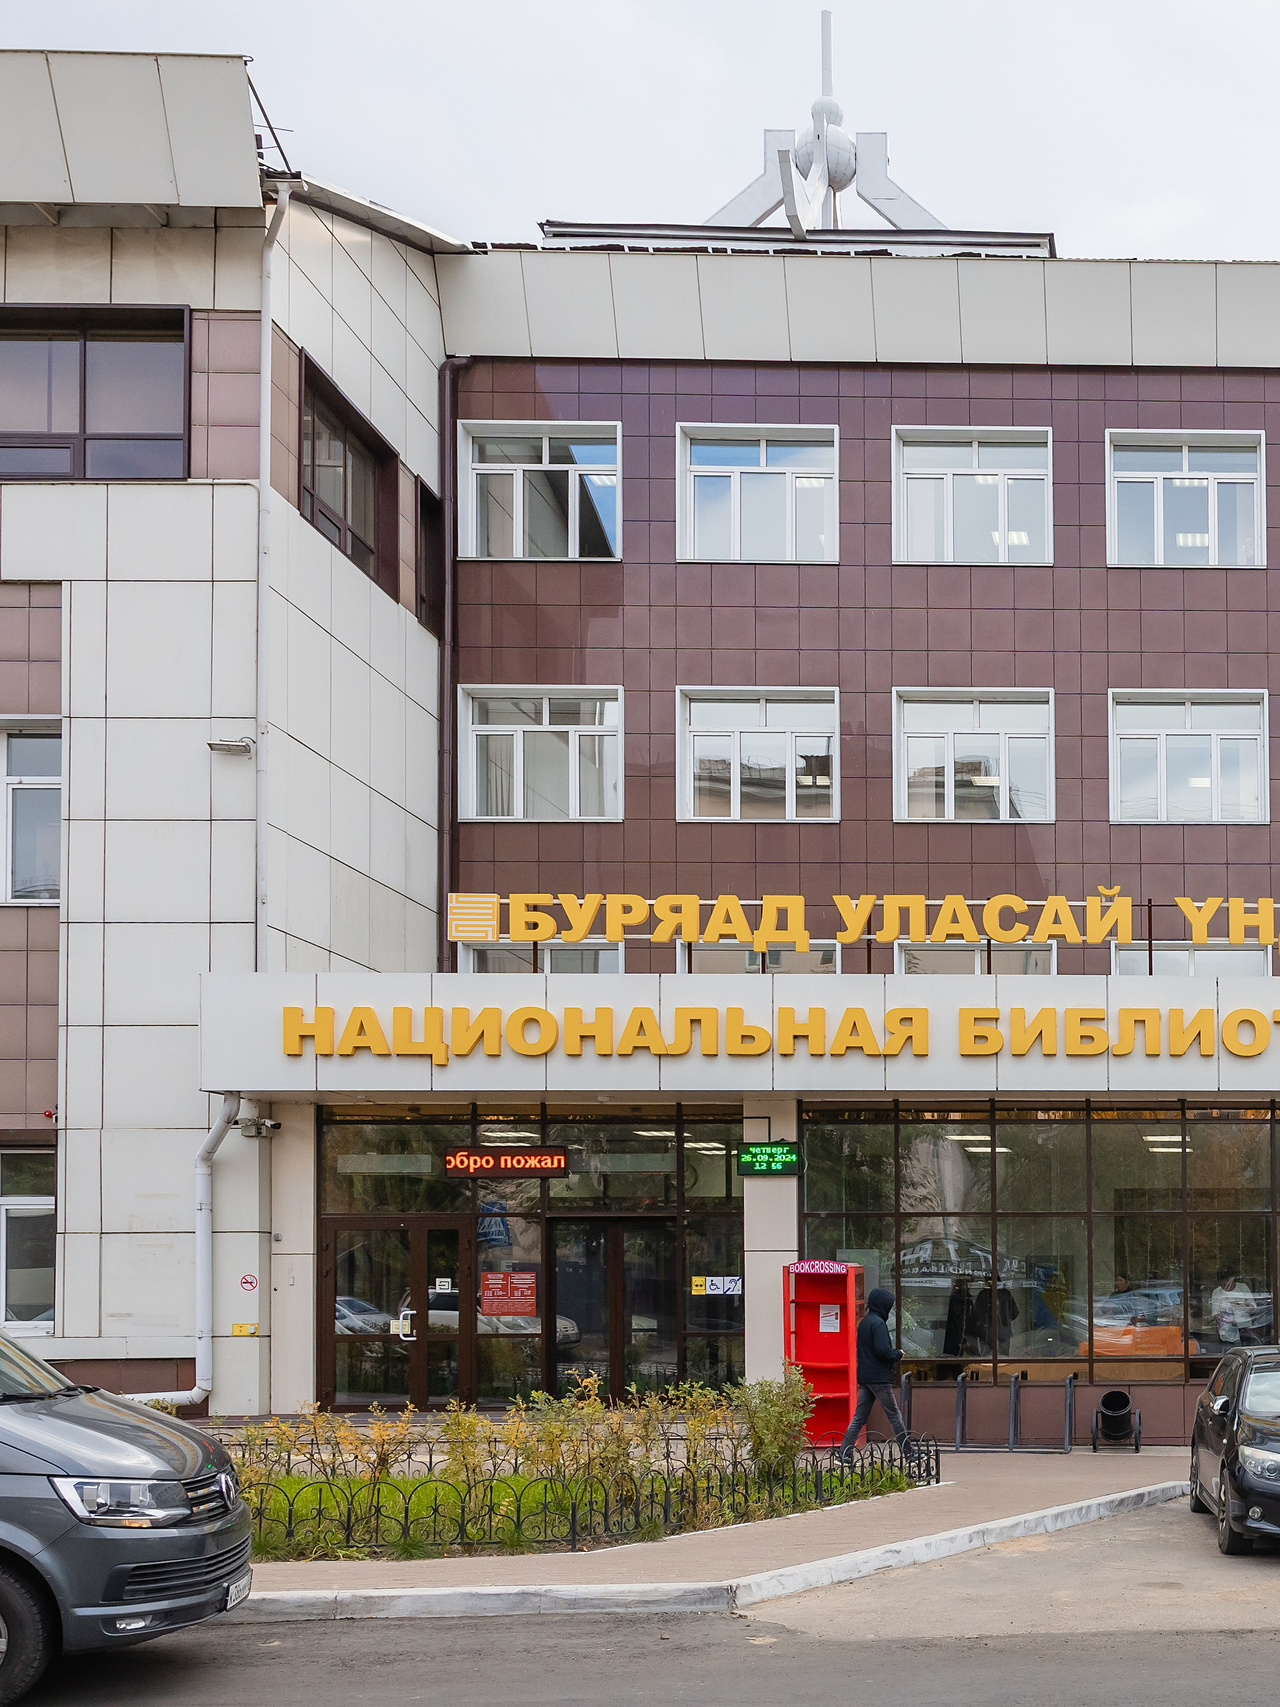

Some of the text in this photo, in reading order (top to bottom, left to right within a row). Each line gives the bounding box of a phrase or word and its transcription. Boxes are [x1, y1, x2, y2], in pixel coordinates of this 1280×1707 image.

[507, 893, 811, 954] БУРЯАД
[833, 885, 1133, 945] УЛАСАЙ
[283, 1006, 929, 1066] НАЦИОНАЛЬНАЯ
[500, 1155, 565, 1169] пожал
[741, 1154, 797, 1162] 26.09.2024
[789, 1261, 847, 1273] BOOKCROSSING
